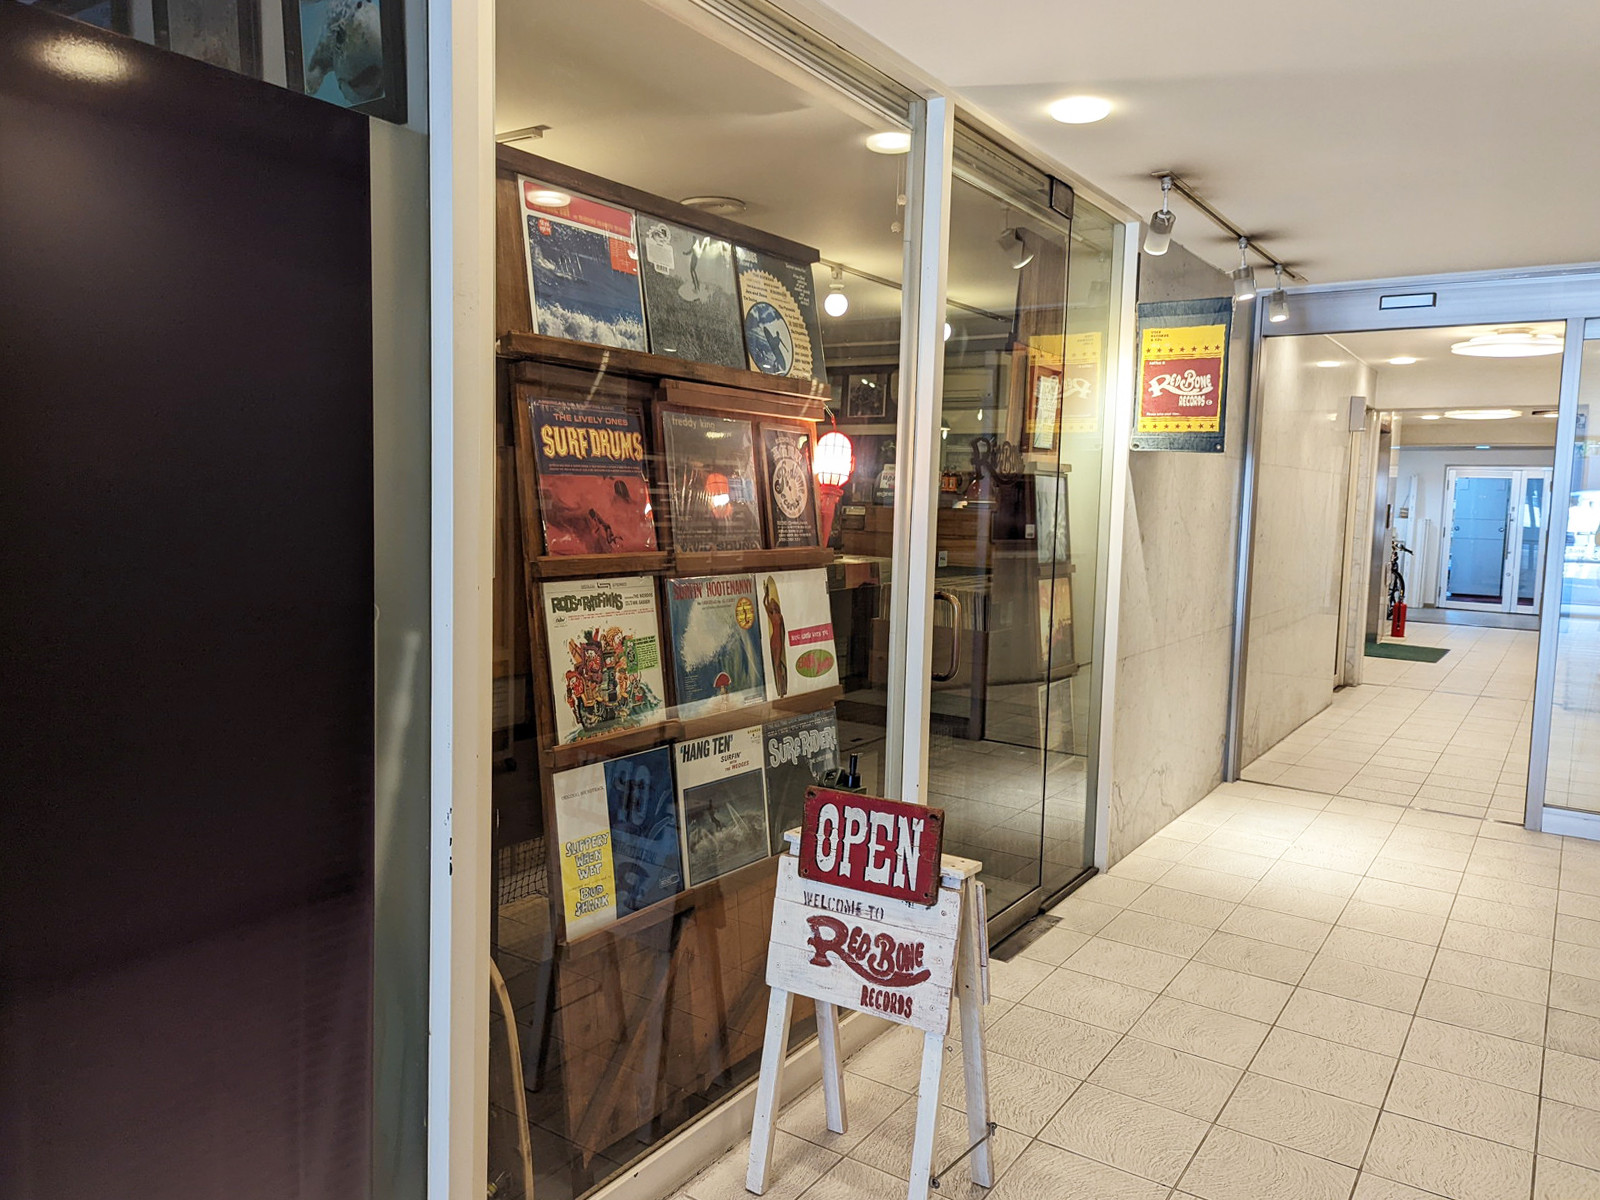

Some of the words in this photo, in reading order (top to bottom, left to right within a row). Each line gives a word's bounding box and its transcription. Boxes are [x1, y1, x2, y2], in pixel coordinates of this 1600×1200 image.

[1178, 395, 1206, 407] RECORDS
[553, 413, 572, 422] THE
[573, 415, 604, 424] LIVELY
[605, 417, 629, 426] ONES
[672, 414, 697, 430] freddy
[700, 418, 716, 430] king
[540, 423, 589, 460] SURF
[587, 427, 644, 462] DRUMS
[706, 578, 754, 598] HOOTENANNY
[720, 751, 742, 763] SURFIN'
[768, 736, 801, 768] SURF
[731, 760, 750, 770] WEDGES
[565, 832, 610, 858] SLIPPERY
[815, 802, 925, 892] OPEN
[574, 848, 603, 868] WHEN
[577, 863, 603, 881] WET
[579, 884, 604, 901] BUD
[575, 895, 610, 918] SHANK
[803, 890, 863, 917] WELCOME
[868, 904, 885, 921] TO
[860, 984, 914, 1019] RECORDS
